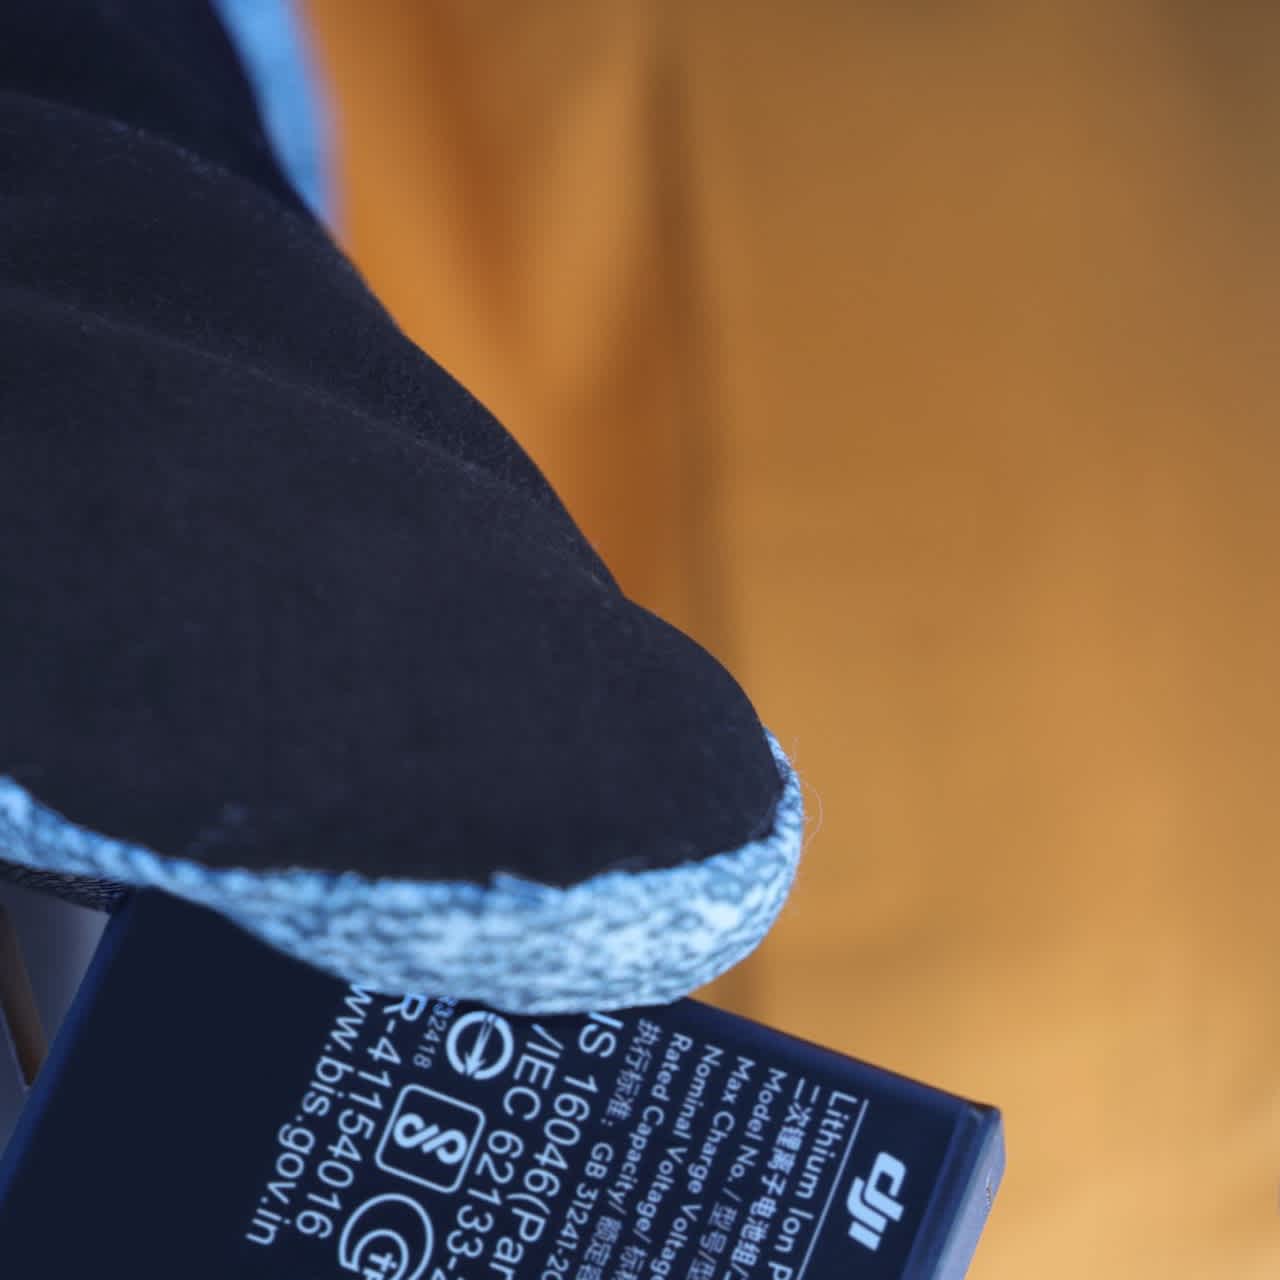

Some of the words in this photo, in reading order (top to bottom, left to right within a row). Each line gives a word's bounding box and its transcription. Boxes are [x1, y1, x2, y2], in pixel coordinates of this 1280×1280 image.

[503, 1024, 564, 1120] /IEC
[651, 1033, 693, 1101] Rated
[673, 1045, 724, 1139] Nominal
[722, 1056, 755, 1103] Max
[745, 1068, 787, 1141] Model
[246, 984, 381, 1245] ww.bis.gov.in
[296, 990, 429, 1238] R-41154016
[688, 1111, 735, 1194] Charge
[795, 1091, 857, 1199] Lithium
[585, 1142, 613, 1179] GB
[607, 1106, 664, 1214] Capacity/
[634, 1147, 688, 1243] Voltage/
[728, 1145, 759, 1182] No.
[774, 1208, 814, 1252] Ion
